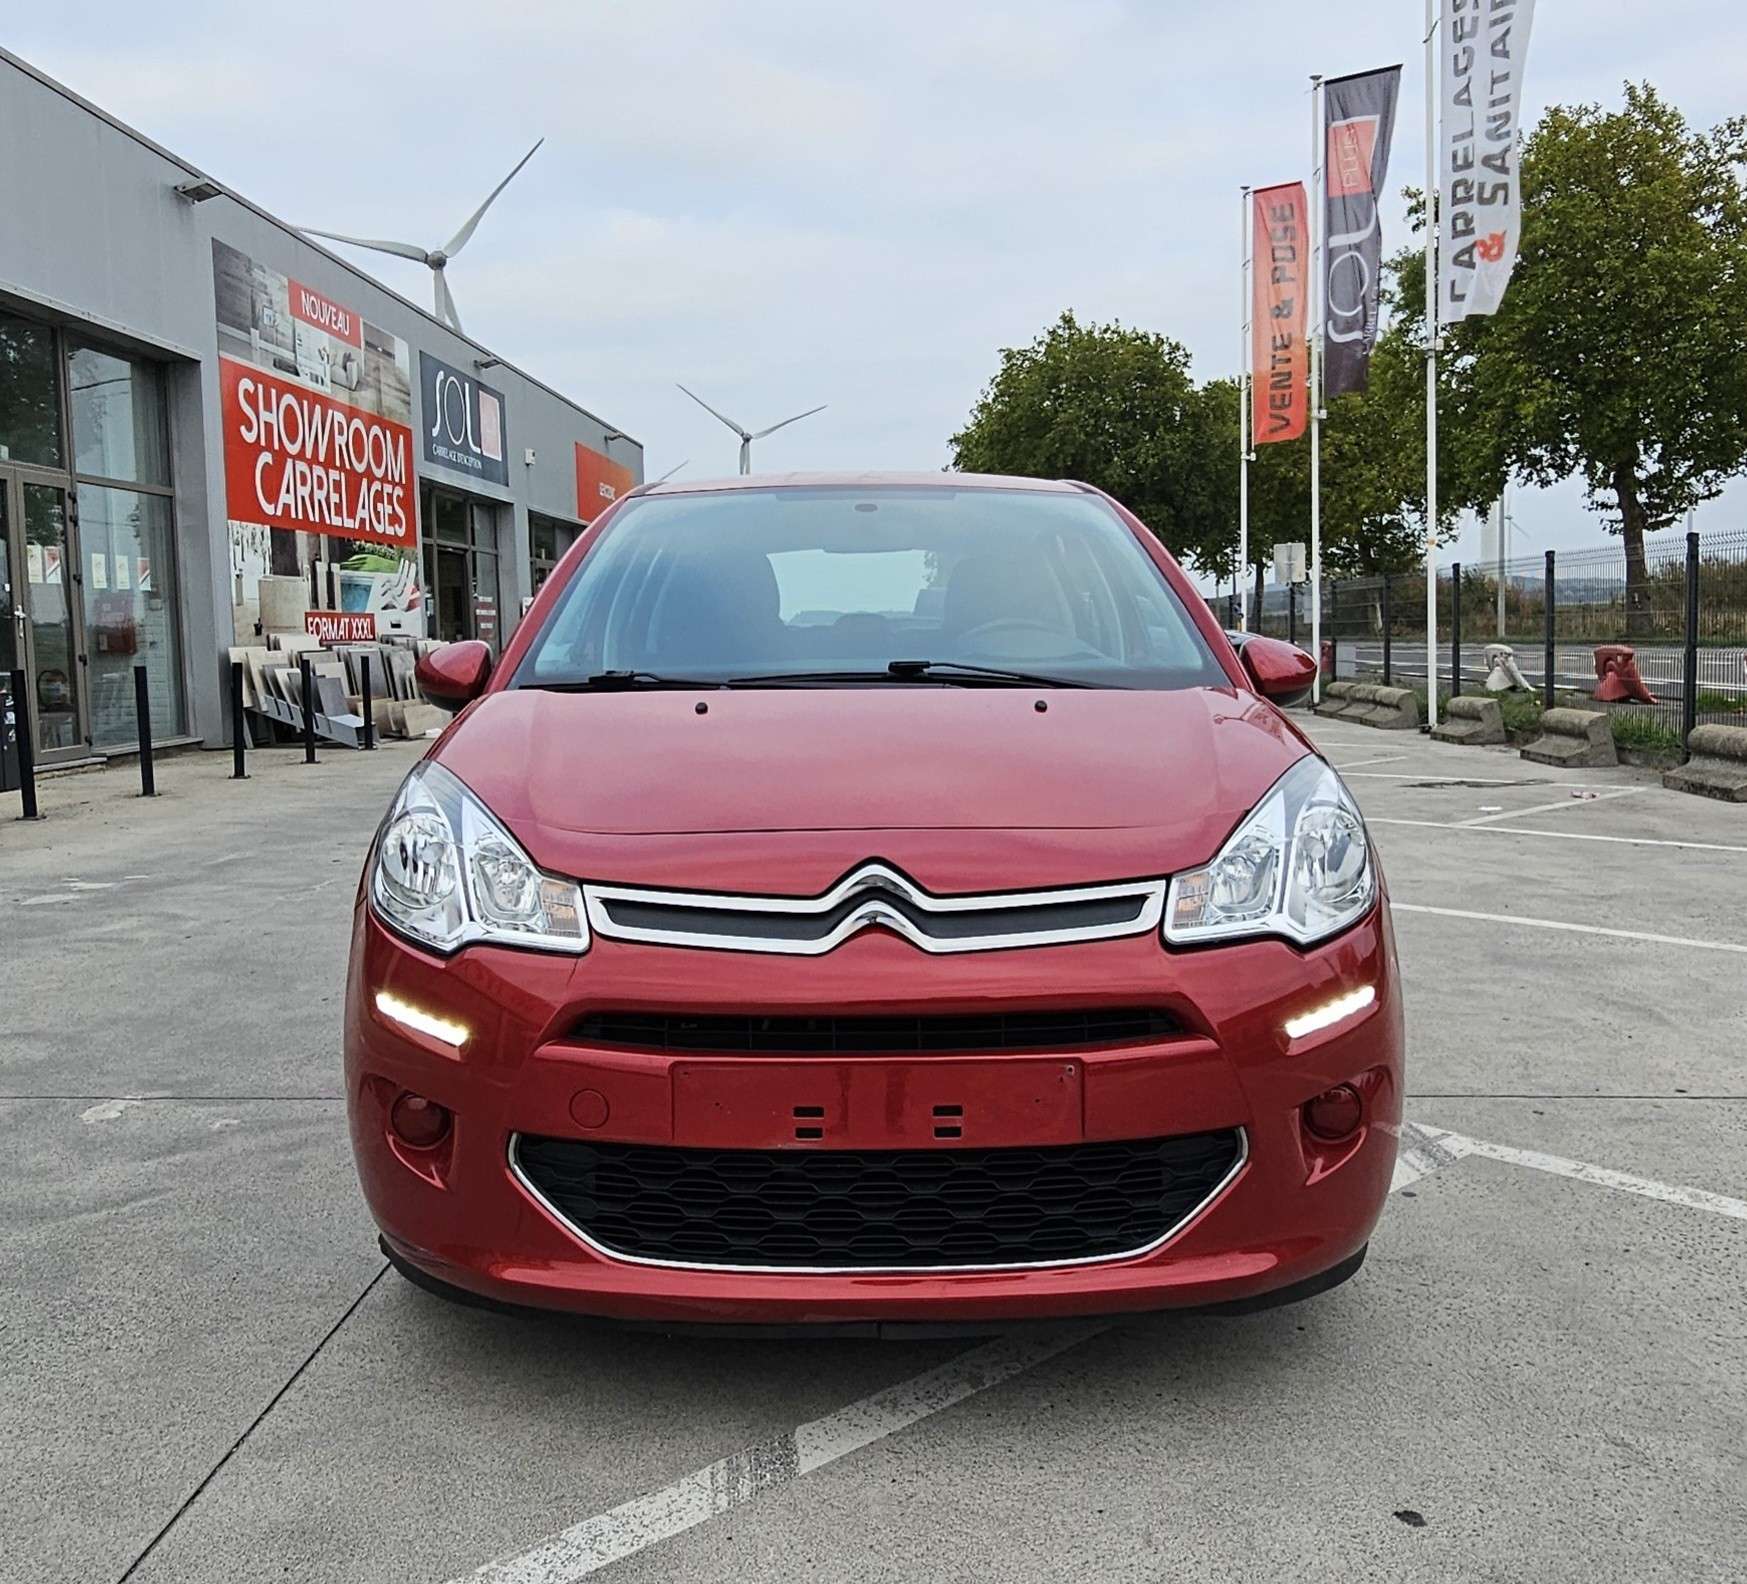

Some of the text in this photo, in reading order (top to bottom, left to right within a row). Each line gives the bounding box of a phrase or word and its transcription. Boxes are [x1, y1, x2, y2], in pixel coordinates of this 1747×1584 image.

[1327, 200, 1377, 343] SOL
[1475, 230, 1507, 263] &
[300, 290, 350, 336] NOUVEAU
[1269, 203, 1296, 435] VENTE & POSE
[238, 377, 406, 484] SHOWROOM
[432, 370, 482, 454] SOL
[255, 451, 407, 537] CARRELAGES
[307, 617, 374, 640] FORMAT XXXL
